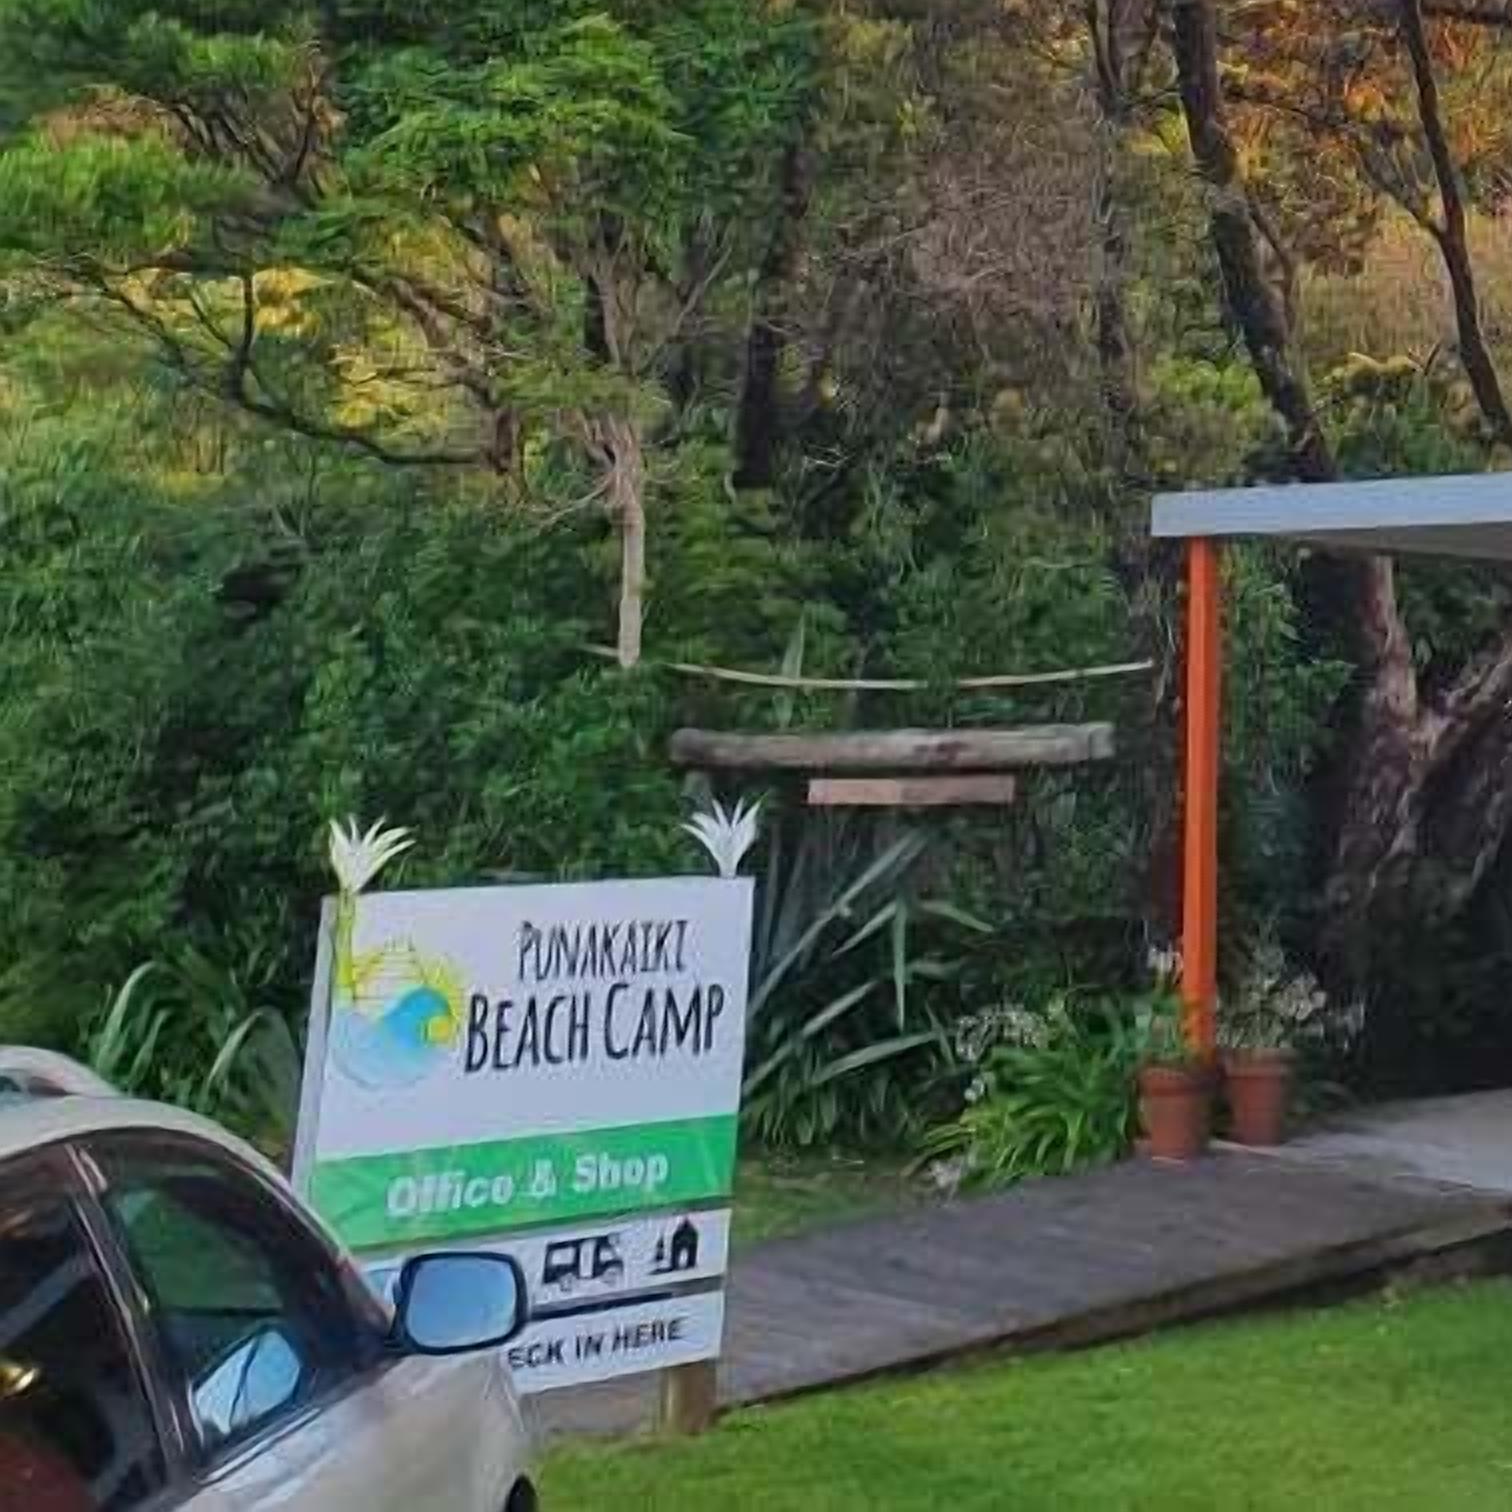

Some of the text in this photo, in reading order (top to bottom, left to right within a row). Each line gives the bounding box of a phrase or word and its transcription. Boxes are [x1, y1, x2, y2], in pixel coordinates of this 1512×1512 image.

[517, 919, 690, 981] PUNAKAIKI
[464, 982, 726, 1074] BEACH CAMP
[386, 1148, 669, 1218] Office & Shop
[508, 1316, 690, 1369] ECK IN HERE
